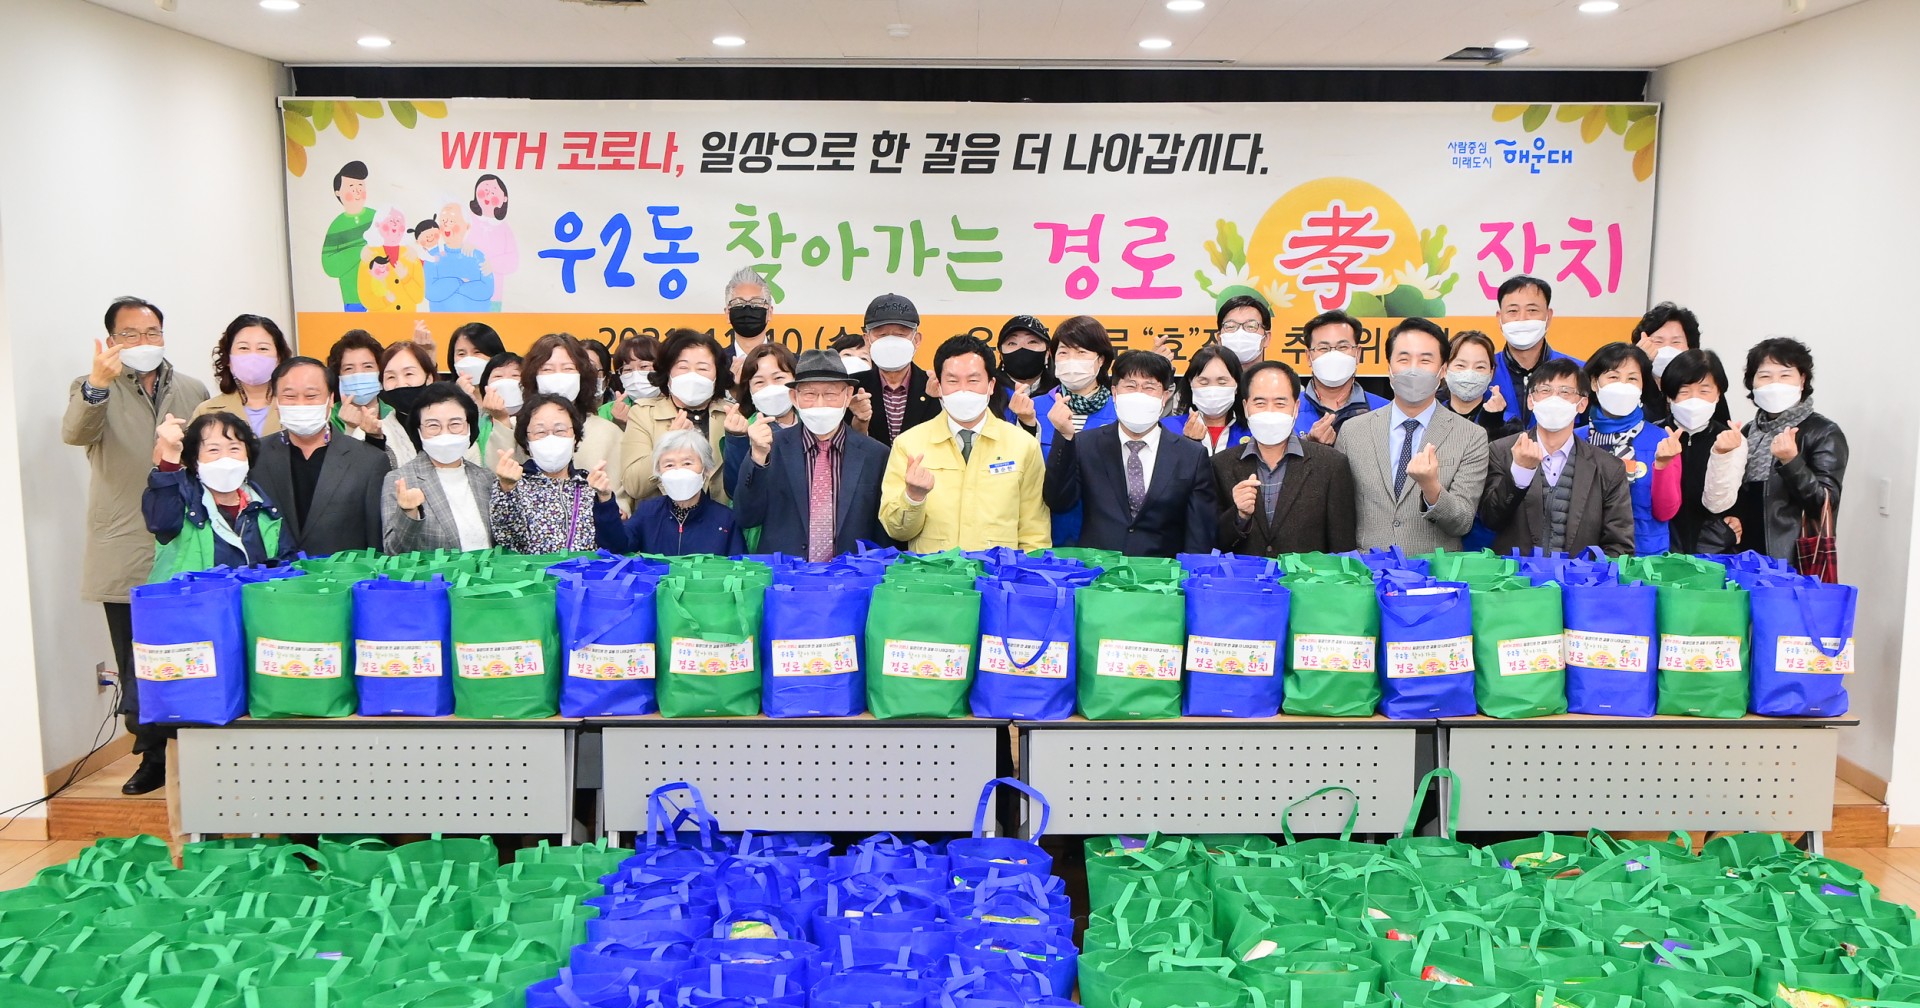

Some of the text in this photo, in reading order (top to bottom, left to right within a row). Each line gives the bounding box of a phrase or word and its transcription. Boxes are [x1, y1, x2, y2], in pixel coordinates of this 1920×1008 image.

[441, 130, 1269, 177] WITH 코로나, 일상으로 한 걸음 더 나아갑시다.
[1447, 141, 1488, 155] 사람중심
[1494, 137, 1573, 175] 해운대
[1452, 156, 1492, 169] 미래도시
[537, 203, 1623, 310] 우2동 찾아가는 경로 孝 잔치
[781, 661, 801, 672] 경로
[988, 658, 1006, 670] 경로
[1195, 658, 1213, 669] 경로
[1248, 662, 1268, 672] 잔치
[1301, 655, 1318, 666] 경로
[1395, 663, 1415, 673] 경로
[1449, 658, 1468, 670] 잔치
[1508, 660, 1527, 671] 경로
[1620, 657, 1640, 667] 잔치
[1665, 656, 1682, 667] 경로
[1715, 658, 1734, 668] 잔치
[627, 665, 649, 676] 잔치
[891, 662, 909, 673] 경로
